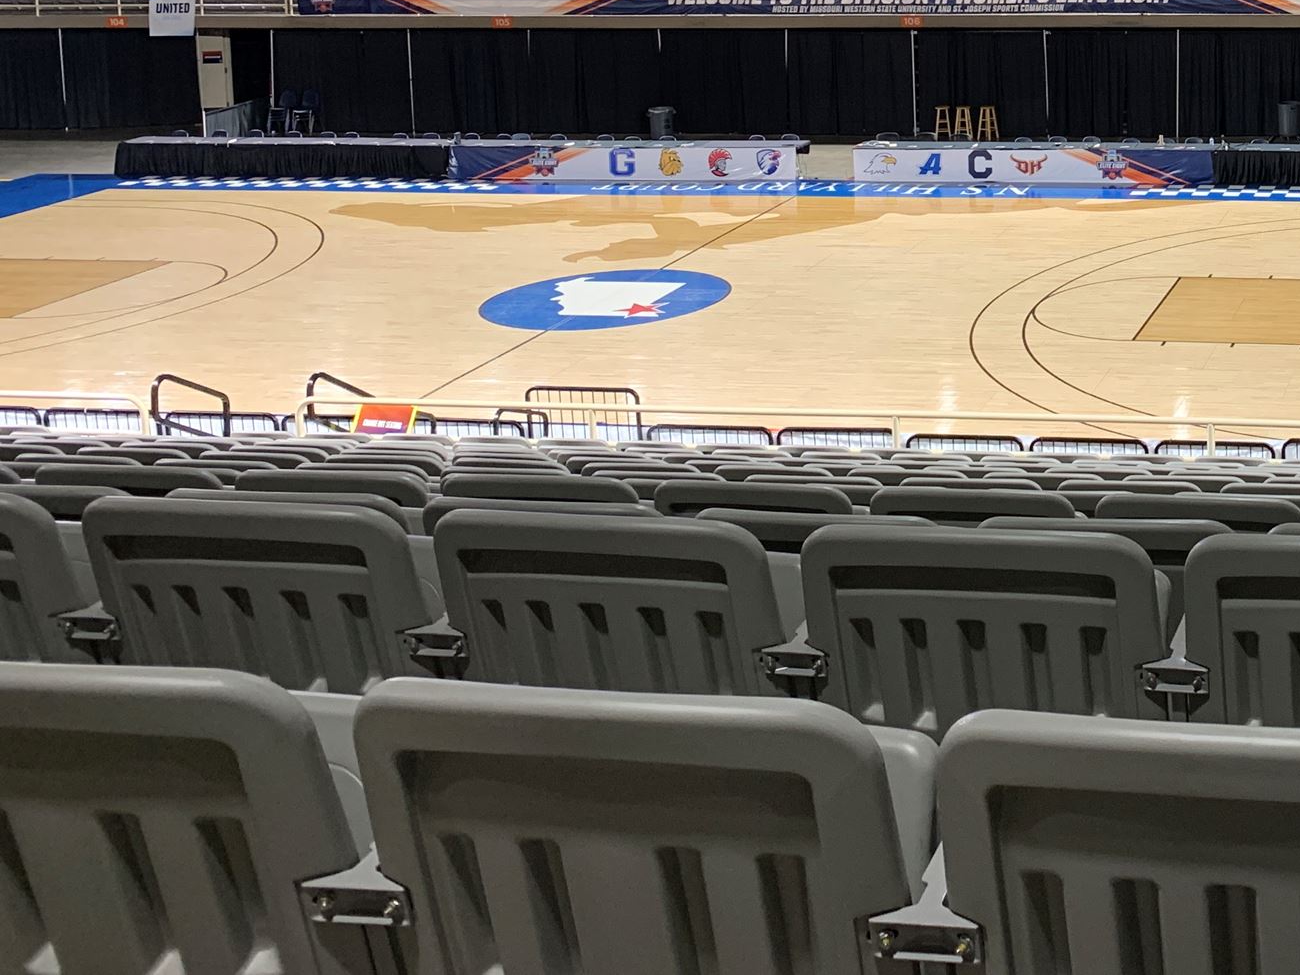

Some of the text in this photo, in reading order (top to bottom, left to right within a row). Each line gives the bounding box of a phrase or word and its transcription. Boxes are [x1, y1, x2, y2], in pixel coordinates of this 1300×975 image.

[156, 3, 190, 13] UNITED
[772, 5, 798, 13] HOSTED
[809, 5, 842, 13] MISSOURI
[844, 5, 879, 13] WESTERN
[880, 5, 896, 13] STATE
[898, 5, 936, 13] UNIVERSITY
[937, 5, 951, 13] AND
[1020, 4, 1065, 12] COMMISSION
[109, 18, 125, 26] 104
[495, 18, 510, 26] 105
[903, 17, 921, 25] 106
[608, 147, 636, 176] G
[919, 153, 942, 175] A
[967, 149, 993, 179] C
